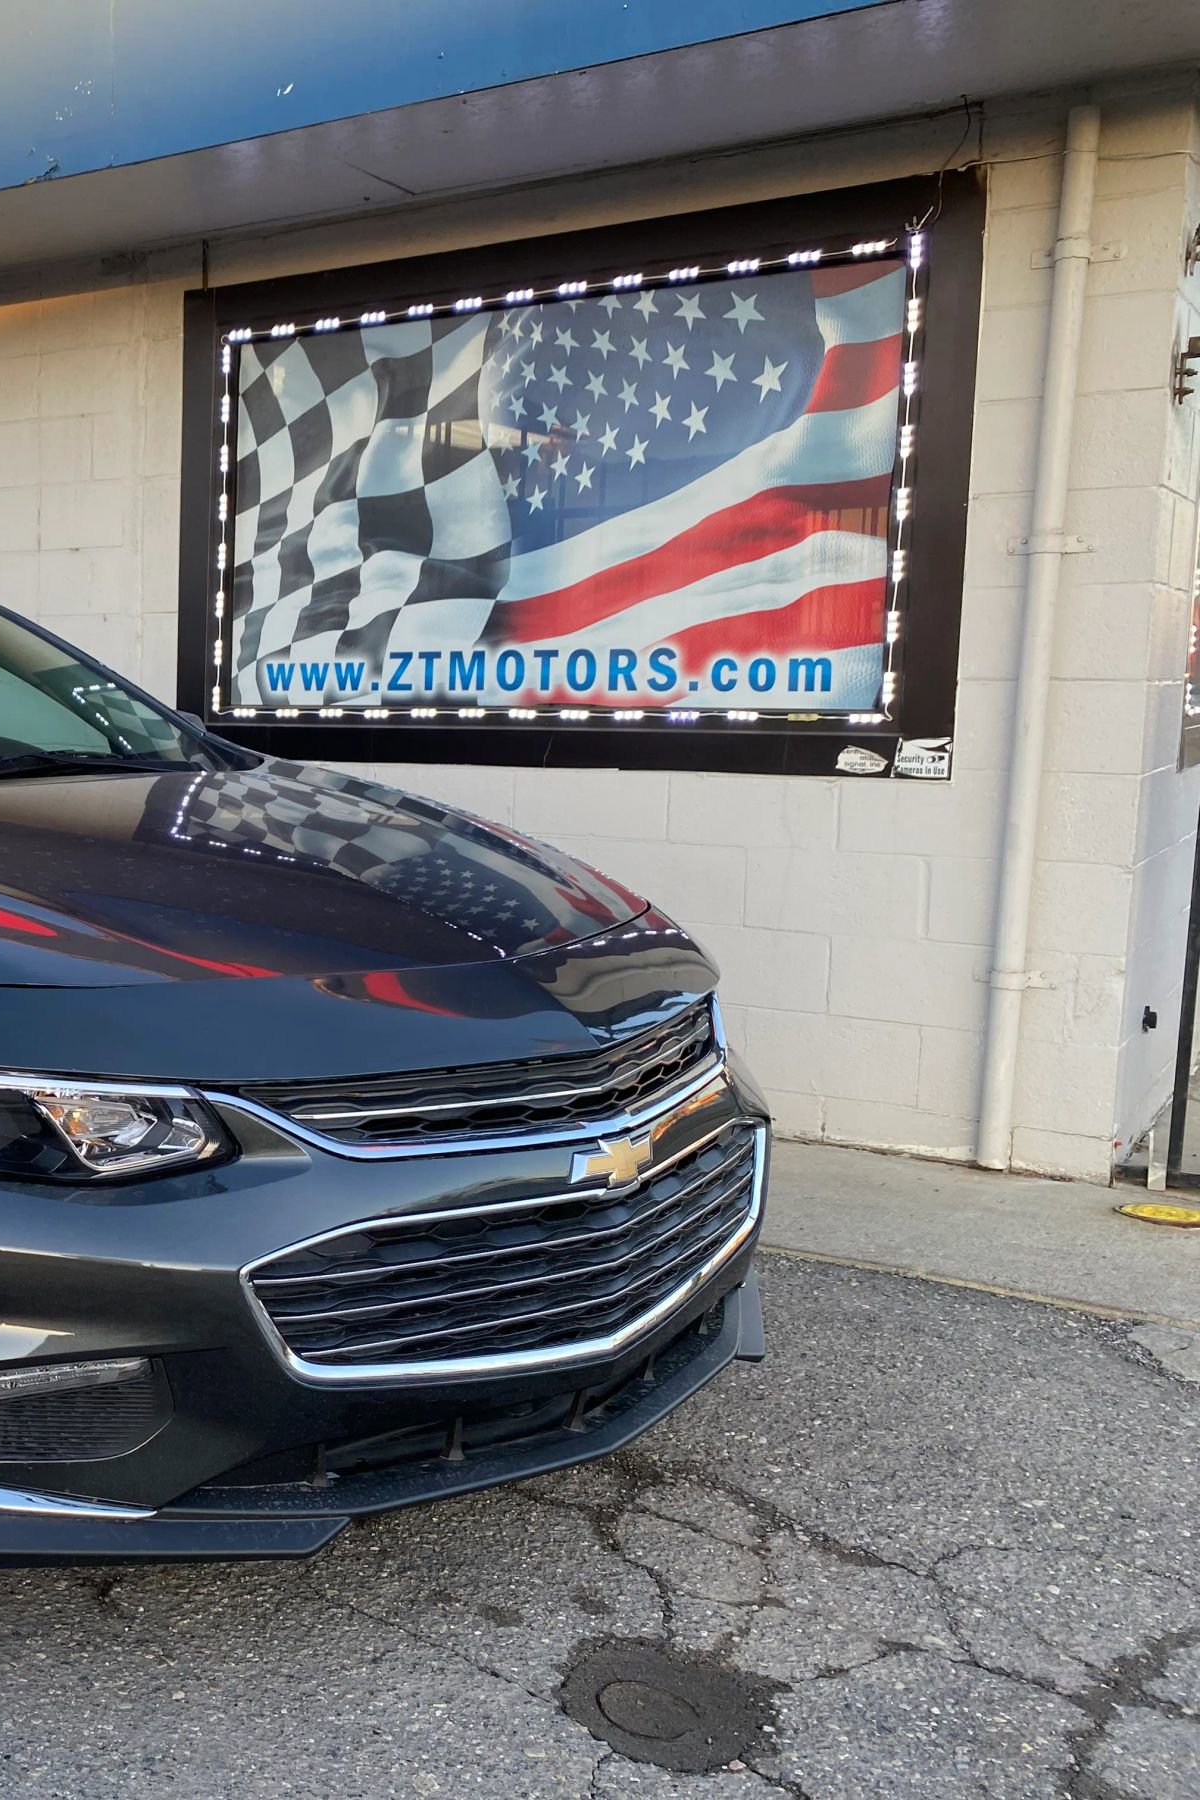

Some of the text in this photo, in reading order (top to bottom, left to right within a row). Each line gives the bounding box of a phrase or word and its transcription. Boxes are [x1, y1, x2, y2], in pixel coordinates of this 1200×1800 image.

[266, 649, 833, 692] www.ZTMOTORS.com
[897, 754, 925, 765] Security
[925, 766, 932, 774] In
[933, 766, 945, 775] Use
